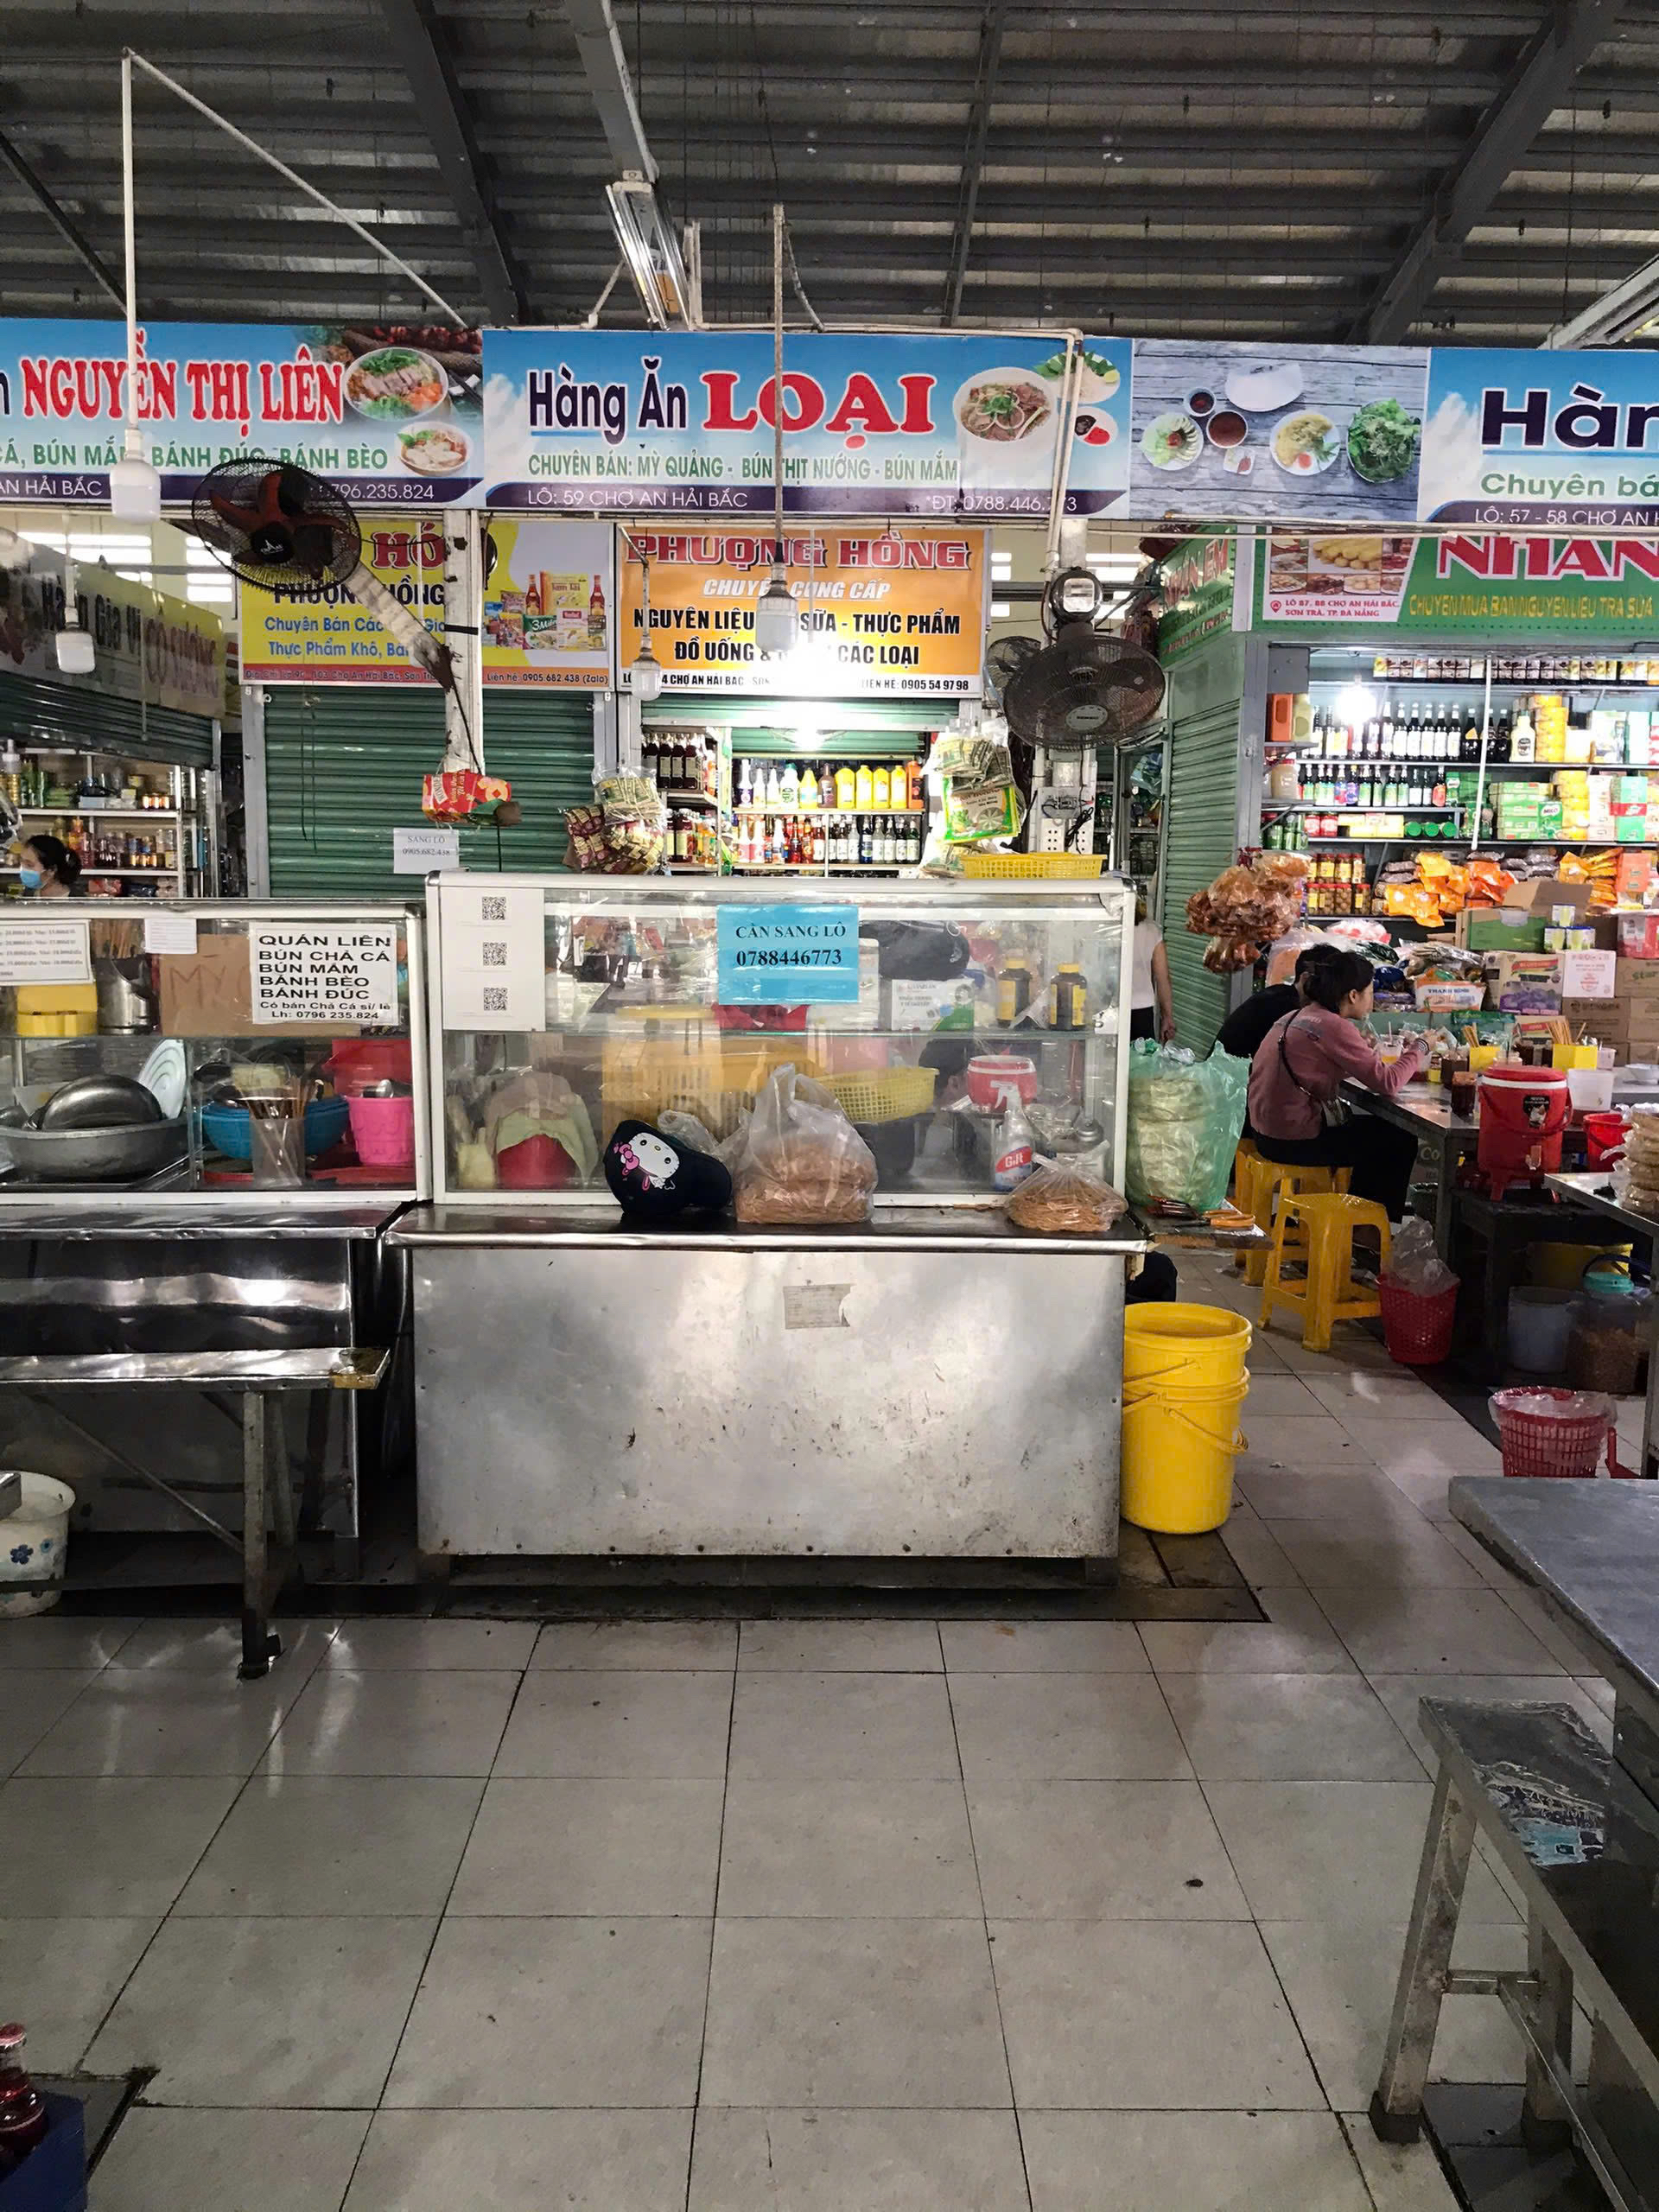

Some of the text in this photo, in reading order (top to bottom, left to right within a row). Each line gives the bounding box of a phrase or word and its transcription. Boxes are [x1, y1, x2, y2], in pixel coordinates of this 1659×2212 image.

[187, 363, 251, 437] THỊ
[260, 346, 343, 423] LIÊN
[528, 358, 936, 448] Hàng Ăn LOẠI
[0, 438, 26, 468] Á,
[34, 438, 76, 466] BÚN
[85, 435, 127, 466] MẮ
[153, 441, 211, 467] BÁNH
[347, 442, 388, 469] BÈO
[529, 450, 590, 475] CHUYÊN
[596, 450, 632, 476] BÁN:
[638, 450, 660, 476] MỲ
[665, 449, 724, 477] QUẢNG
[742, 452, 772, 479] BÚN
[813, 455, 870, 480] NƯỚNG
[884, 452, 915, 480] BÚN
[920, 450, 957, 481] MẮM
[26, 476, 56, 495] HẢI
[62, 476, 102, 496] BẮC
[320, 483, 435, 499] 796.235.824
[1481, 474, 1605, 499] Chuyên
[528, 487, 748, 509] LÔ: 59 CHỢ AN HẢI BẮC
[963, 496, 1077, 512] 0788.446.3
[1475, 506, 1503, 524] LÔ:
[1510, 509, 1530, 523] 57
[1547, 510, 1567, 525] 58
[627, 530, 969, 571] PHƯỢNG HỒNG
[274, 582, 359, 609] PHƯỢN
[704, 577, 891, 599] CHUYÊ CUNG CẤP
[264, 616, 319, 633] Chuyên
[323, 616, 350, 632] Bán
[354, 616, 384, 632] Các
[634, 607, 960, 637] NGUYÊN LIỆU SỮA THỰC PHẨM
[269, 641, 301, 659] Thực
[306, 637, 346, 657] Phẩm
[352, 640, 382, 658] Khô,
[675, 636, 700, 661] ĐỒ
[705, 637, 754, 662] UỐNG
[880, 645, 918, 669] LOẠI
[582, 673, 608, 685] (Zalo)
[671, 673, 690, 687] CHỢ
[692, 675, 704, 685] AN
[901, 679, 926, 690] 0905
[929, 680, 940, 690] 54
[943, 680, 954, 690] 97
[956, 680, 969, 690] 98
[408, 836, 431, 844] SANG
[774, 925, 819, 938] SANG
[823, 921, 846, 938] LÔ
[259, 934, 391, 948] QUÁN LIÊN
[259, 949, 302, 961] BÚN
[361, 950, 391, 962] CÁ
[736, 950, 842, 966] 0788446773
[259, 962, 302, 974] BÚN
[260, 974, 370, 988] BÁNH BÈO
[261, 987, 370, 1000] BÁNH ĐÚC
[260, 1001, 278, 1009] Có
[283, 1001, 306, 1010] bán
